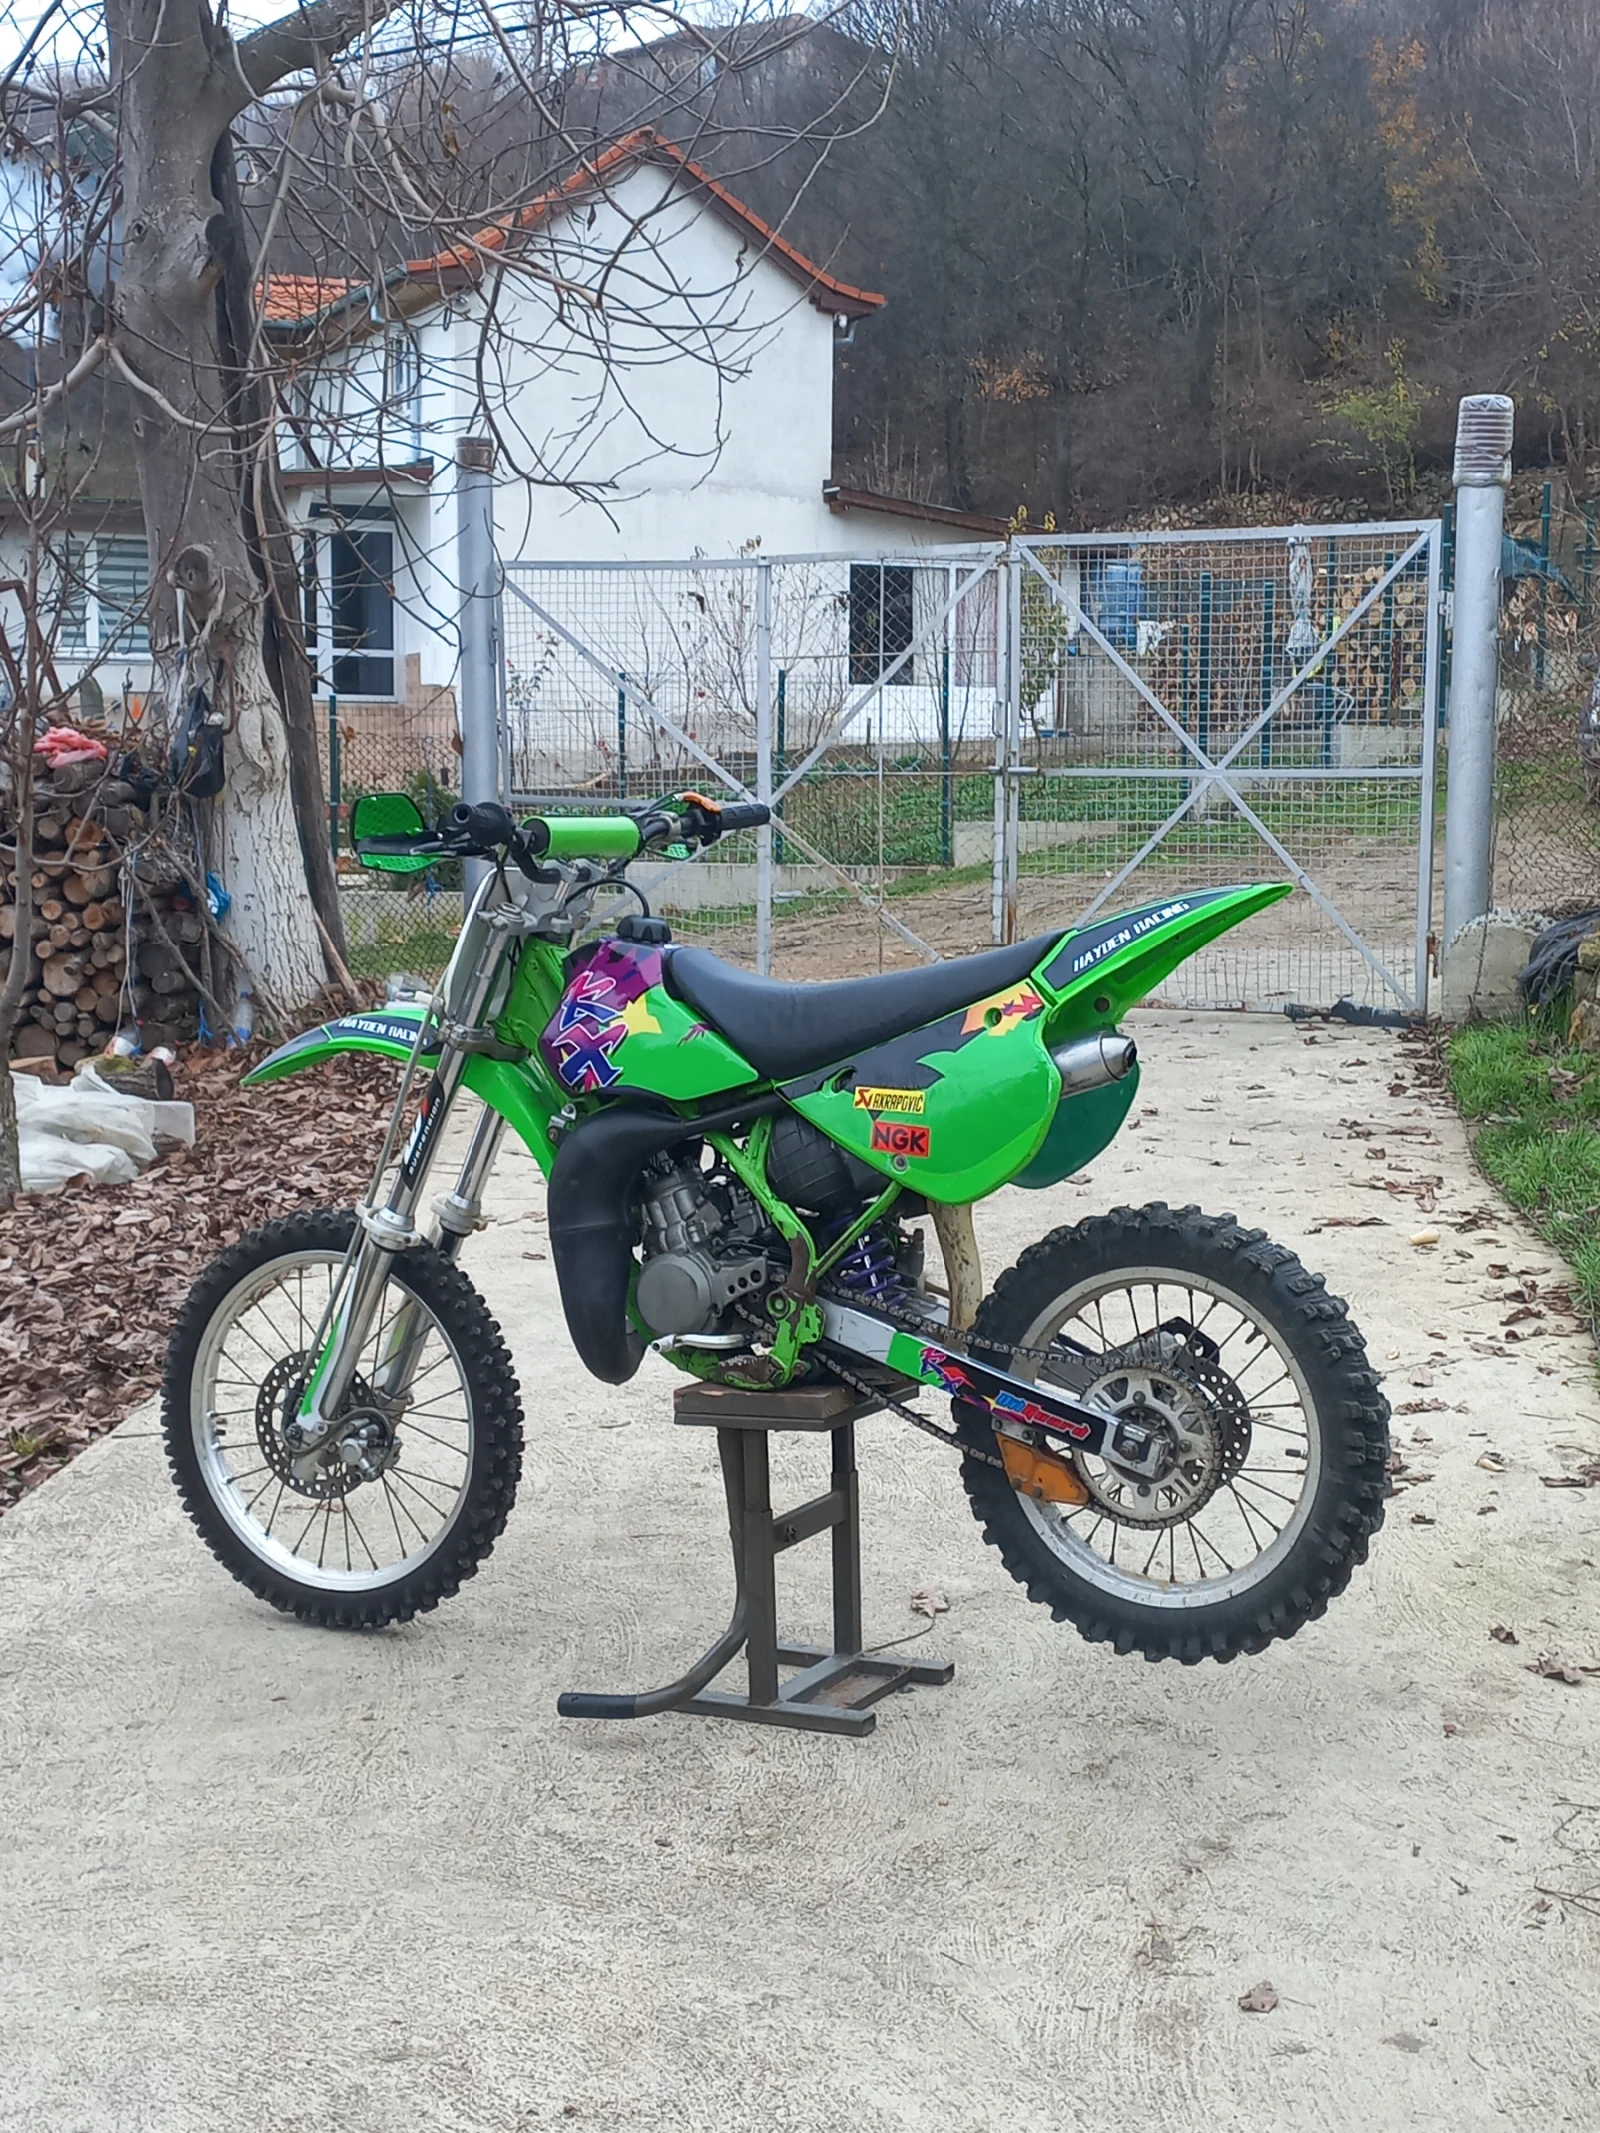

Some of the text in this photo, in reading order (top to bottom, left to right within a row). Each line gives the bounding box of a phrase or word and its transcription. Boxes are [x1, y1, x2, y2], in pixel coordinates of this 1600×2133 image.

[1073, 901, 1190, 973] HAYDEN RACING
[338, 1017, 428, 1046] HAYDEN RACIN
[874, 1126, 926, 1153] NGK
